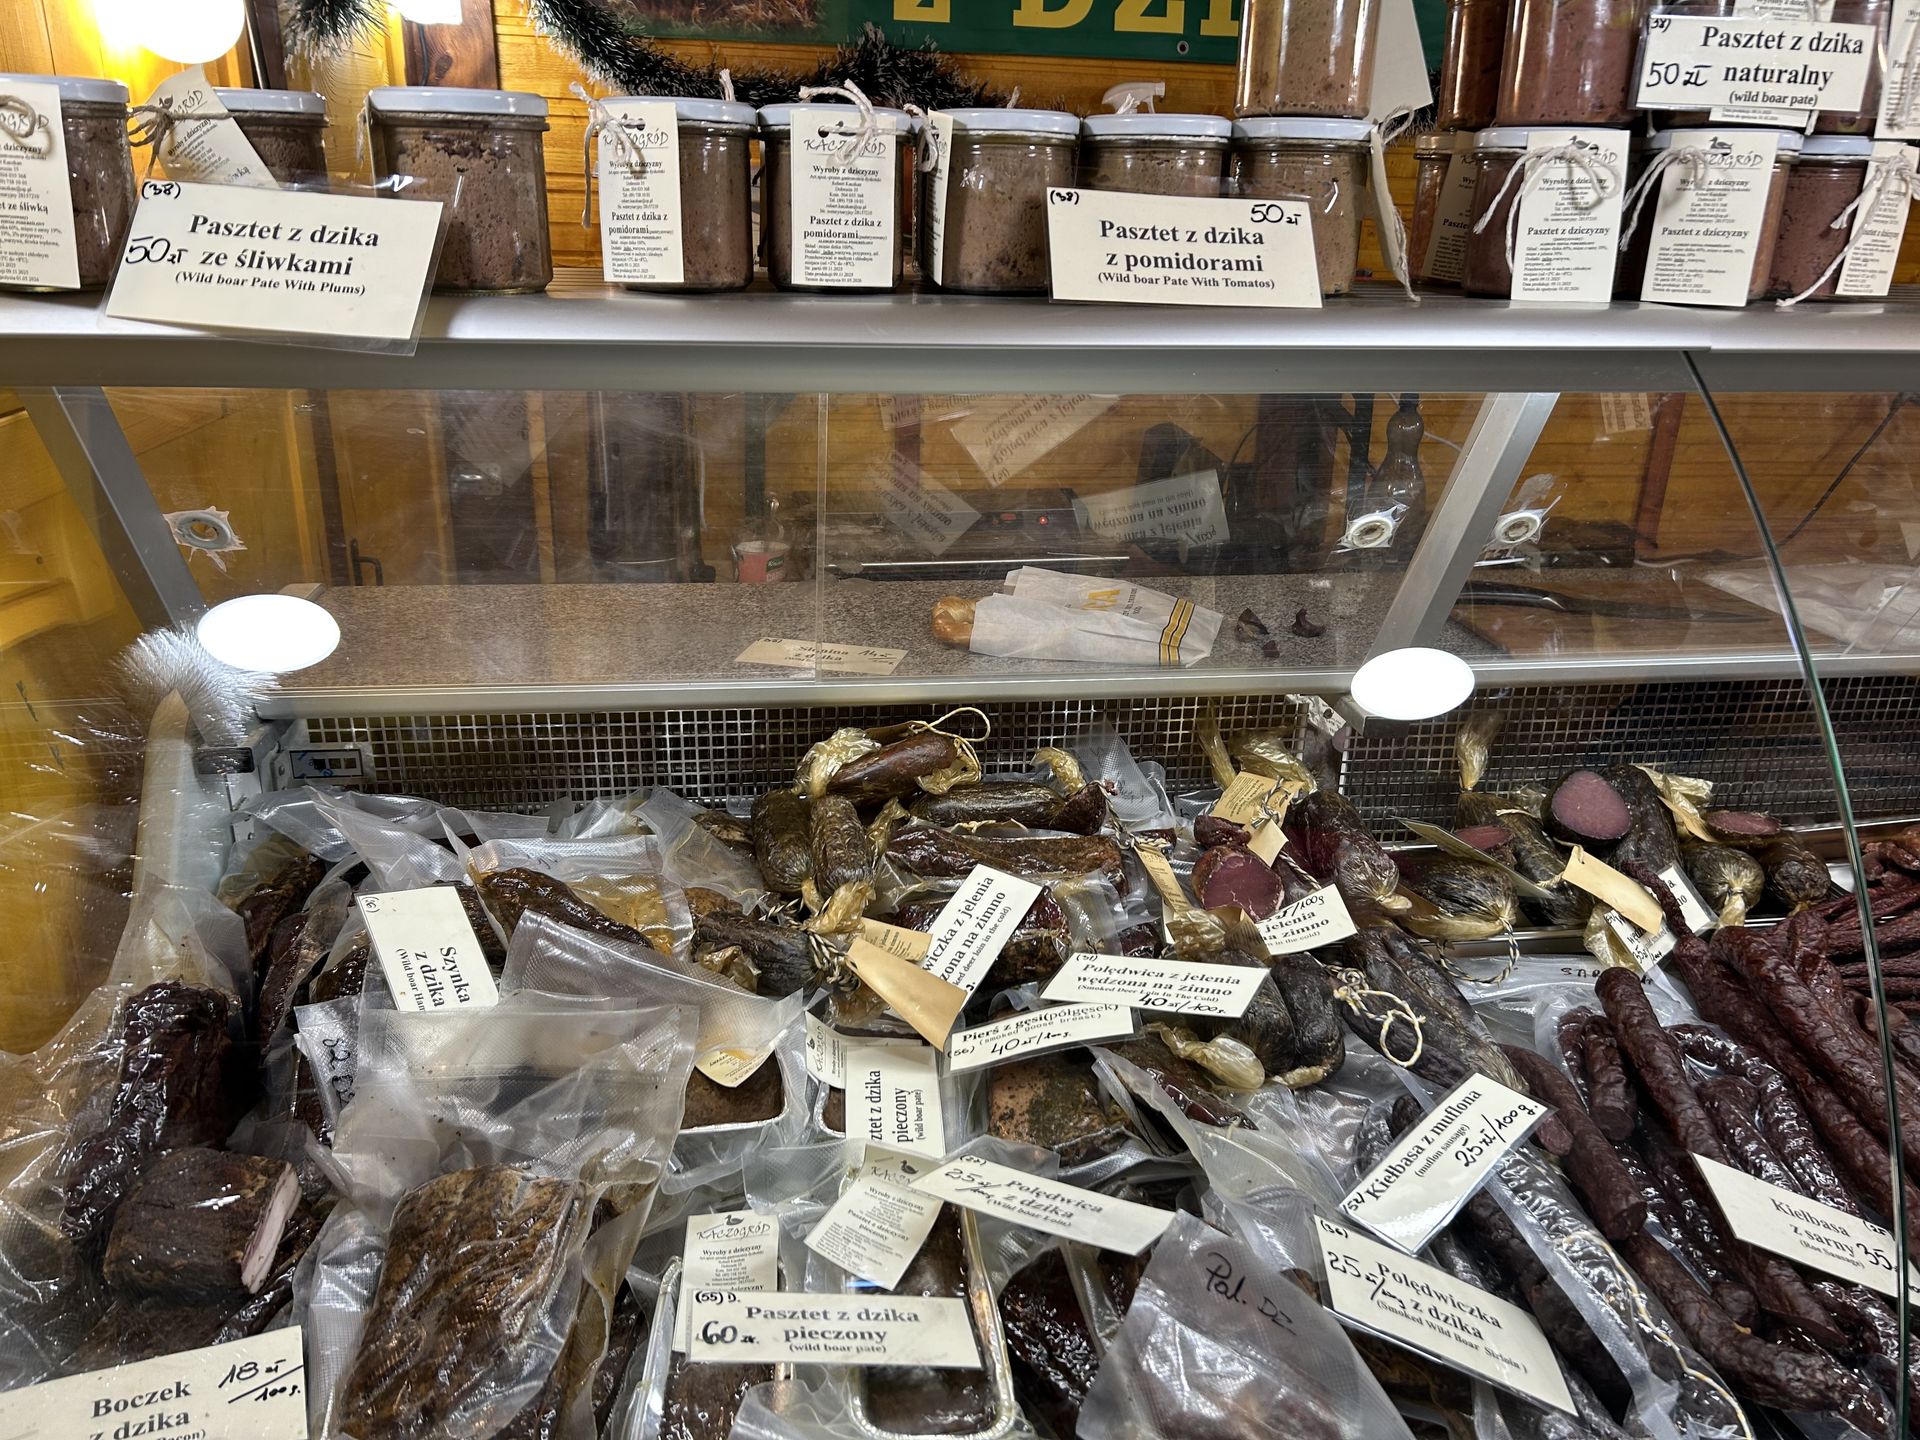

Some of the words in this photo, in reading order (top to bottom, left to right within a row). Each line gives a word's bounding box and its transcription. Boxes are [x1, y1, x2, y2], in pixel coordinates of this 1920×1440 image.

[1700, 25, 1785, 50] Pasztet
[1791, 36, 1802, 51] z
[1809, 31, 1863, 54] dzika
[1723, 64, 1833, 91] naturalny
[1729, 90, 1759, 104] (wild
[1761, 93, 1787, 105] boar
[1790, 95, 1818, 107] pate)
[813, 165, 840, 174] Wyroby
[848, 167, 879, 177] dziczyzny
[141, 181, 181, 199] (38)
[1714, 179, 1750, 187] dziczyzny
[20, 201, 48, 214] śliwką
[1050, 190, 1080, 205] (38)
[611, 212, 636, 221] Pasztet
[641, 212, 662, 221] dzika
[810, 215, 842, 226] Pasztet
[851, 217, 875, 227] dzika
[877, 219, 882, 227] z
[188, 214, 283, 241] Pasztet
[288, 226, 302, 242] z
[313, 222, 379, 247] dzika
[608, 225, 649, 236] pomidorami
[803, 229, 859, 239] pomidorami
[1099, 219, 1179, 242] Pasztet
[1186, 230, 1198, 243] z
[1204, 227, 1265, 245] dzika
[1527, 227, 1559, 236] Pasztet
[1567, 226, 1611, 237] dziczyzny
[1661, 227, 1695, 236] Pasztet
[1702, 228, 1750, 238] dziczyzny
[199, 250, 227, 267] ze
[234, 247, 352, 276] śliwkami
[1106, 253, 1118, 266] z
[1125, 252, 1264, 272] pomidorami
[175, 272, 213, 285] (Wild
[216, 275, 248, 287] boar
[250, 277, 281, 290] Pate
[282, 279, 317, 292] With
[319, 282, 366, 297] Plums)
[1098, 272, 1131, 284] (Wild
[1134, 274, 1161, 285] boar
[1164, 276, 1189, 287] Pate
[1191, 277, 1220, 288] With
[1222, 278, 1275, 290] Tomatos)
[958, 876, 995, 920] jelenia
[954, 917, 965, 928] z
[996, 905, 1013, 926] cold)
[1265, 911, 1316, 933] jelenia
[939, 949, 967, 983] zona
[964, 930, 980, 949] na
[975, 891, 1007, 931] zimno
[987, 924, 1000, 940] the
[1281, 918, 1329, 938] zimno
[923, 928, 957, 972] wiczka
[974, 943, 987, 958] loin
[984, 936, 992, 947] in
[415, 951, 428, 960] z
[962, 954, 978, 972] deer
[396, 948, 413, 973] (Wild
[406, 973, 418, 991] boar
[440, 946, 471, 1003] Szynka
[1082, 963, 1165, 979] Polędwica
[1169, 971, 1182, 980] z
[1180, 973, 1241, 985] jelenia
[419, 963, 445, 1007] dzika
[1077, 975, 1148, 990] wędzona
[1153, 982, 1174, 990] na
[1178, 983, 1234, 997] zimno
[1077, 984, 1116, 993] (Smoked
[1119, 987, 1139, 995] Deer
[1193, 994, 1219, 1003] Cold)
[962, 1026, 1000, 1042] Pierś
[1003, 1024, 1012, 1032] z
[865, 1070, 883, 1104] dzika
[914, 1090, 924, 1104] pate)
[870, 1106, 882, 1116] z
[892, 1088, 914, 1144] pieczony
[914, 1105, 925, 1121] boar
[868, 1116, 883, 1142] ztet
[914, 1121, 927, 1142] (wild
[1366, 1143, 1426, 1201] Kiełbasa
[1421, 1134, 1434, 1146] z
[1432, 1088, 1483, 1136] muflona
[1414, 1147, 1444, 1178] (muflon
[1440, 1123, 1470, 1152] sausage)
[1005, 1179, 1103, 1213] Polędwica
[1020, 1199, 1074, 1219] dzika
[1790, 1224, 1803, 1236] z
[1804, 1229, 1855, 1257] sarny
[1376, 1262, 1503, 1329] Polędwiczka
[745, 1306, 830, 1322] Pasztet
[837, 1311, 850, 1322] z
[856, 1307, 920, 1323] dzika
[1376, 1299, 1424, 1326] (Smoked
[1424, 1317, 1451, 1338] Wild
[1410, 1298, 1424, 1311] z
[1427, 1301, 1484, 1340] dzika
[784, 1325, 887, 1344] pieczony
[789, 1343, 821, 1353] (wild
[823, 1343, 853, 1353] boar
[855, 1344, 887, 1354] pate)
[91, 1381, 193, 1419] Boczek
[113, 1411, 190, 1440] dzika
